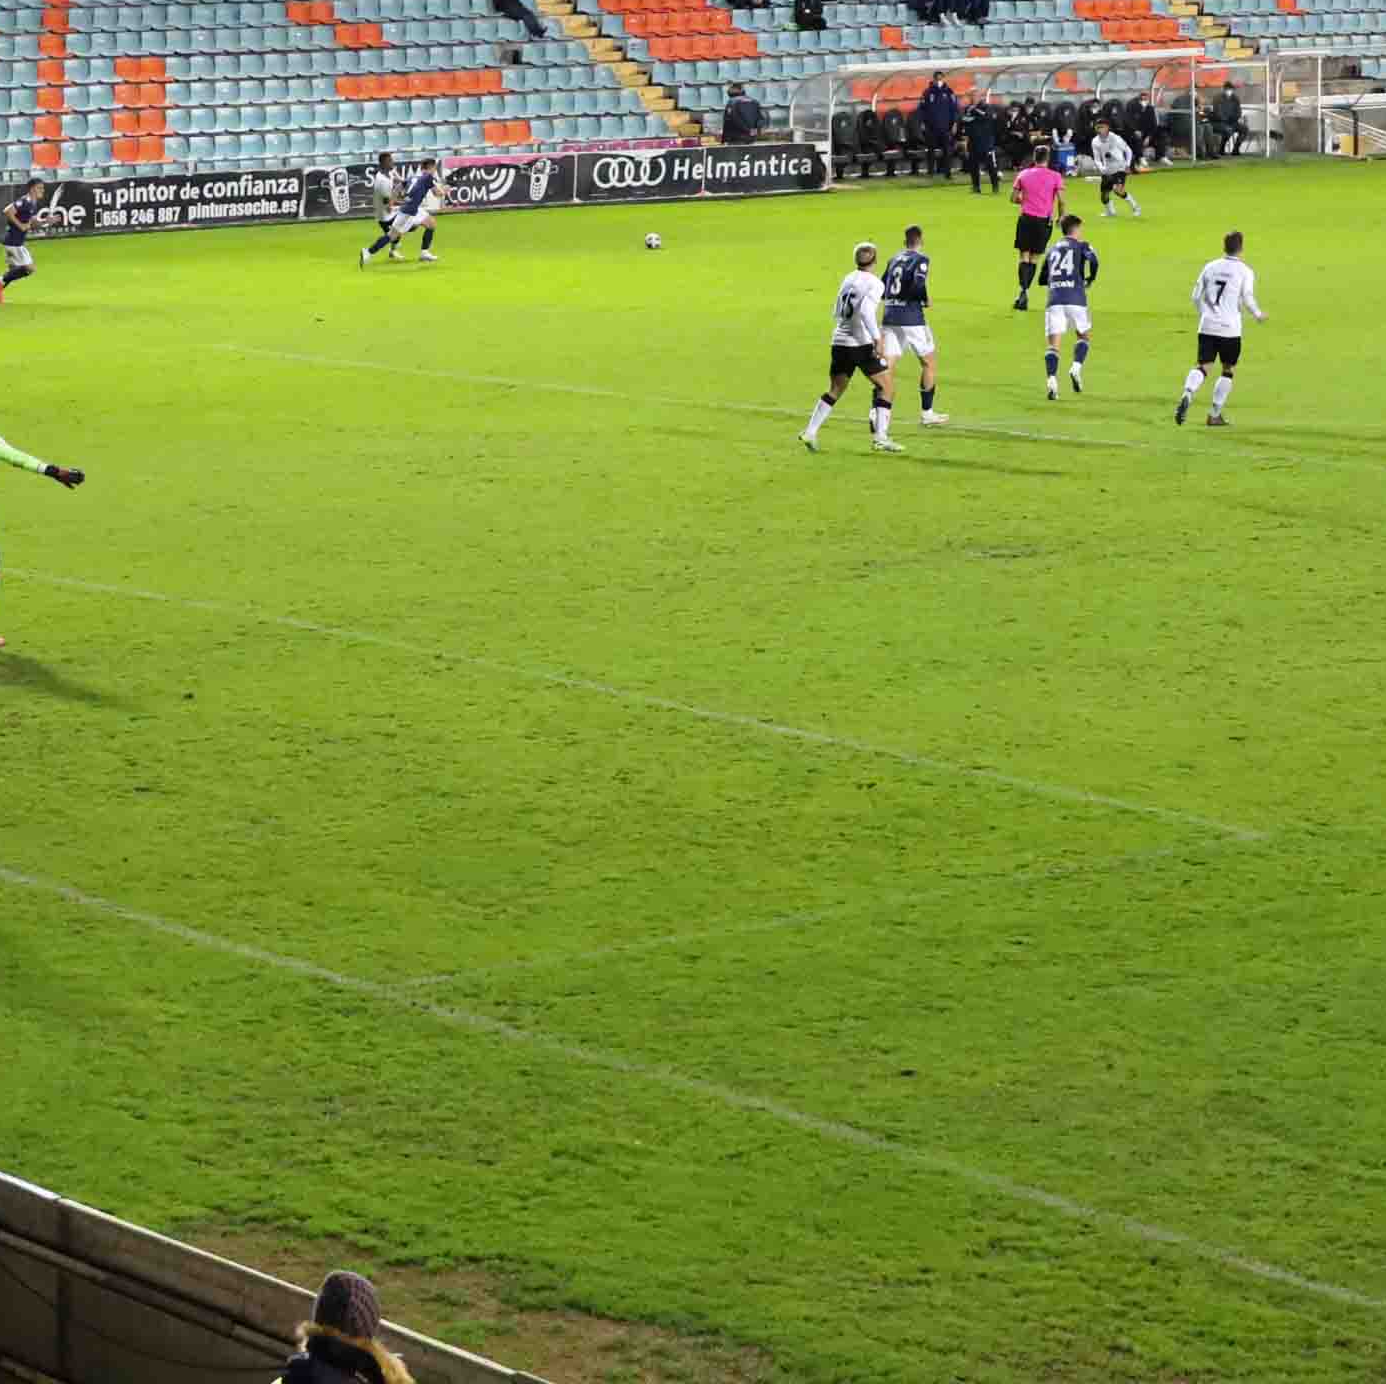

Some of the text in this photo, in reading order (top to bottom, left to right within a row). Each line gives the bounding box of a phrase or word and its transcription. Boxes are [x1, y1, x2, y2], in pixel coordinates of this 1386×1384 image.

[673, 153, 813, 182] Helmántica
[93, 174, 299, 208] Tu pintor de confianza
[103, 198, 298, 226] 658 246 887 pinturasoche.es
[1050, 249, 1074, 275] 24
[1215, 280, 1227, 306] 7
